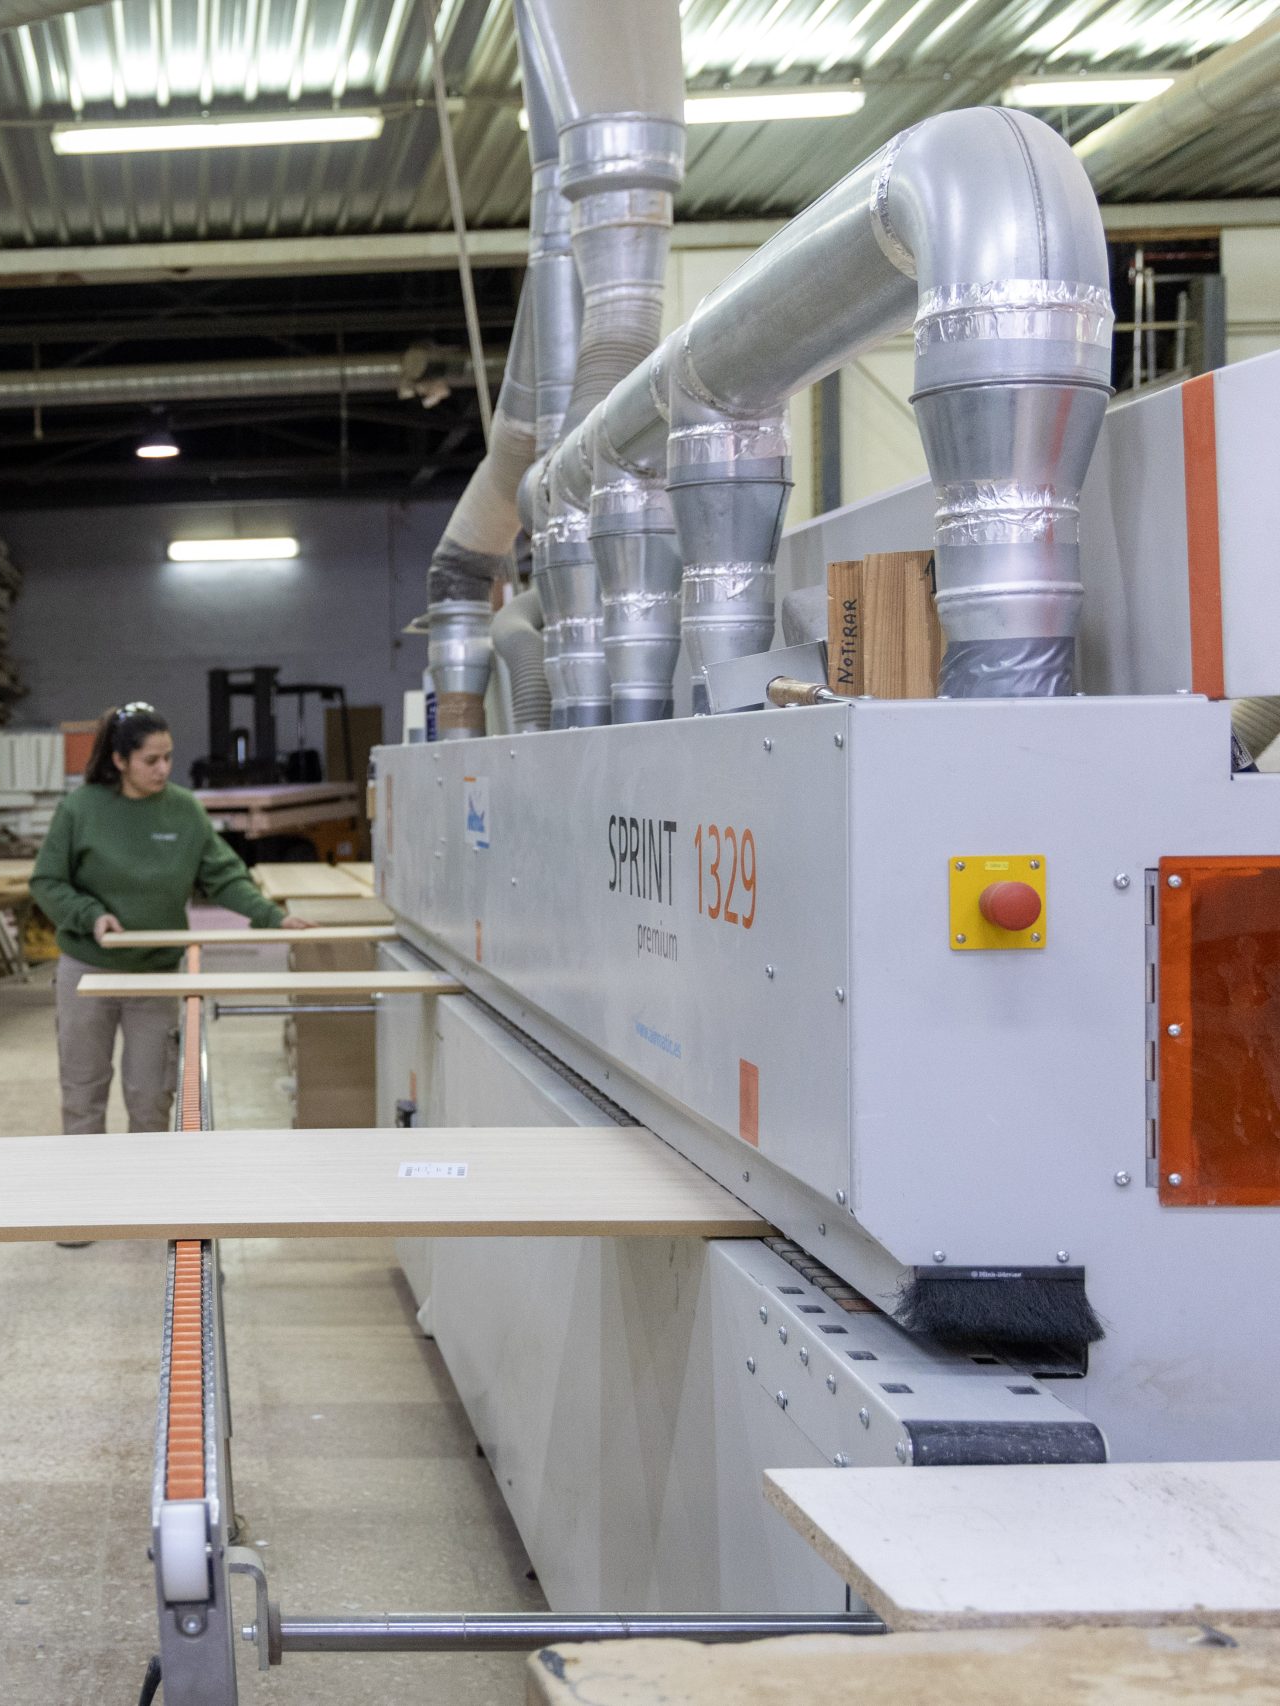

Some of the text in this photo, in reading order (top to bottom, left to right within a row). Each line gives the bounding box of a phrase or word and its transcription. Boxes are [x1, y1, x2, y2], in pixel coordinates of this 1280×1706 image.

[608, 814, 757, 930] SPRINT 1329
[637, 920, 678, 962] premium
